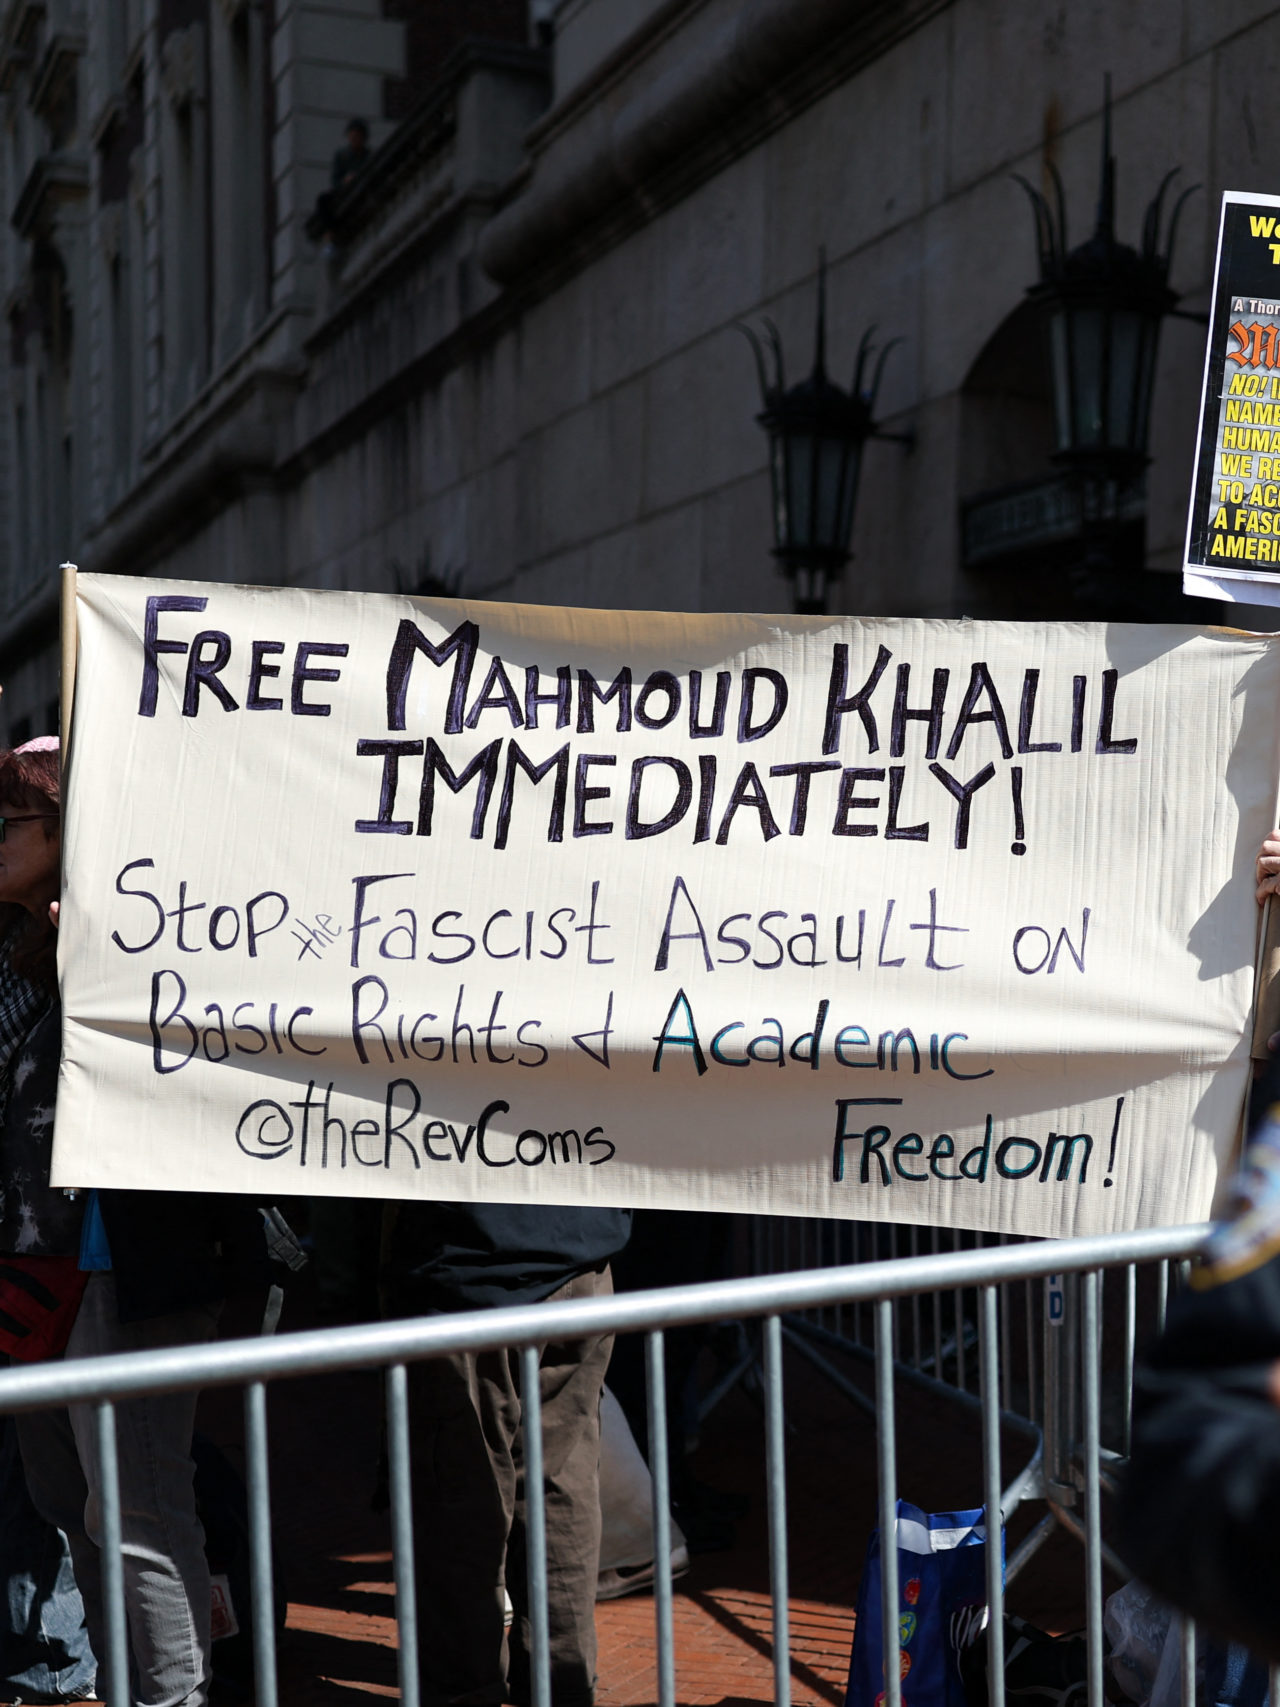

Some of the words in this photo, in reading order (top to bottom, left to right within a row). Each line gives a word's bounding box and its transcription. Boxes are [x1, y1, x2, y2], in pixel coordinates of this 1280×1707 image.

[1233, 300, 1244, 312] A
[1228, 373, 1269, 398] NO!
[1218, 479, 1245, 504] TO
[1220, 453, 1253, 478] WE
[1213, 507, 1229, 530] A
[138, 595, 349, 718] FREE
[387, 619, 788, 742] MAHMOUD
[822, 643, 1137, 760] KHALIL
[354, 738, 1027, 856] IMMEDIATELY!
[111, 858, 289, 958] Stop
[290, 910, 342, 961] the
[348, 873, 614, 968] Fascist
[654, 875, 970, 972] Assault
[150, 970, 326, 1075] Basic
[351, 975, 549, 1067] Rights
[652, 988, 994, 1081] Academic
[236, 1079, 615, 1169] @theRevComs
[833, 1097, 1124, 1188] Freedom!
